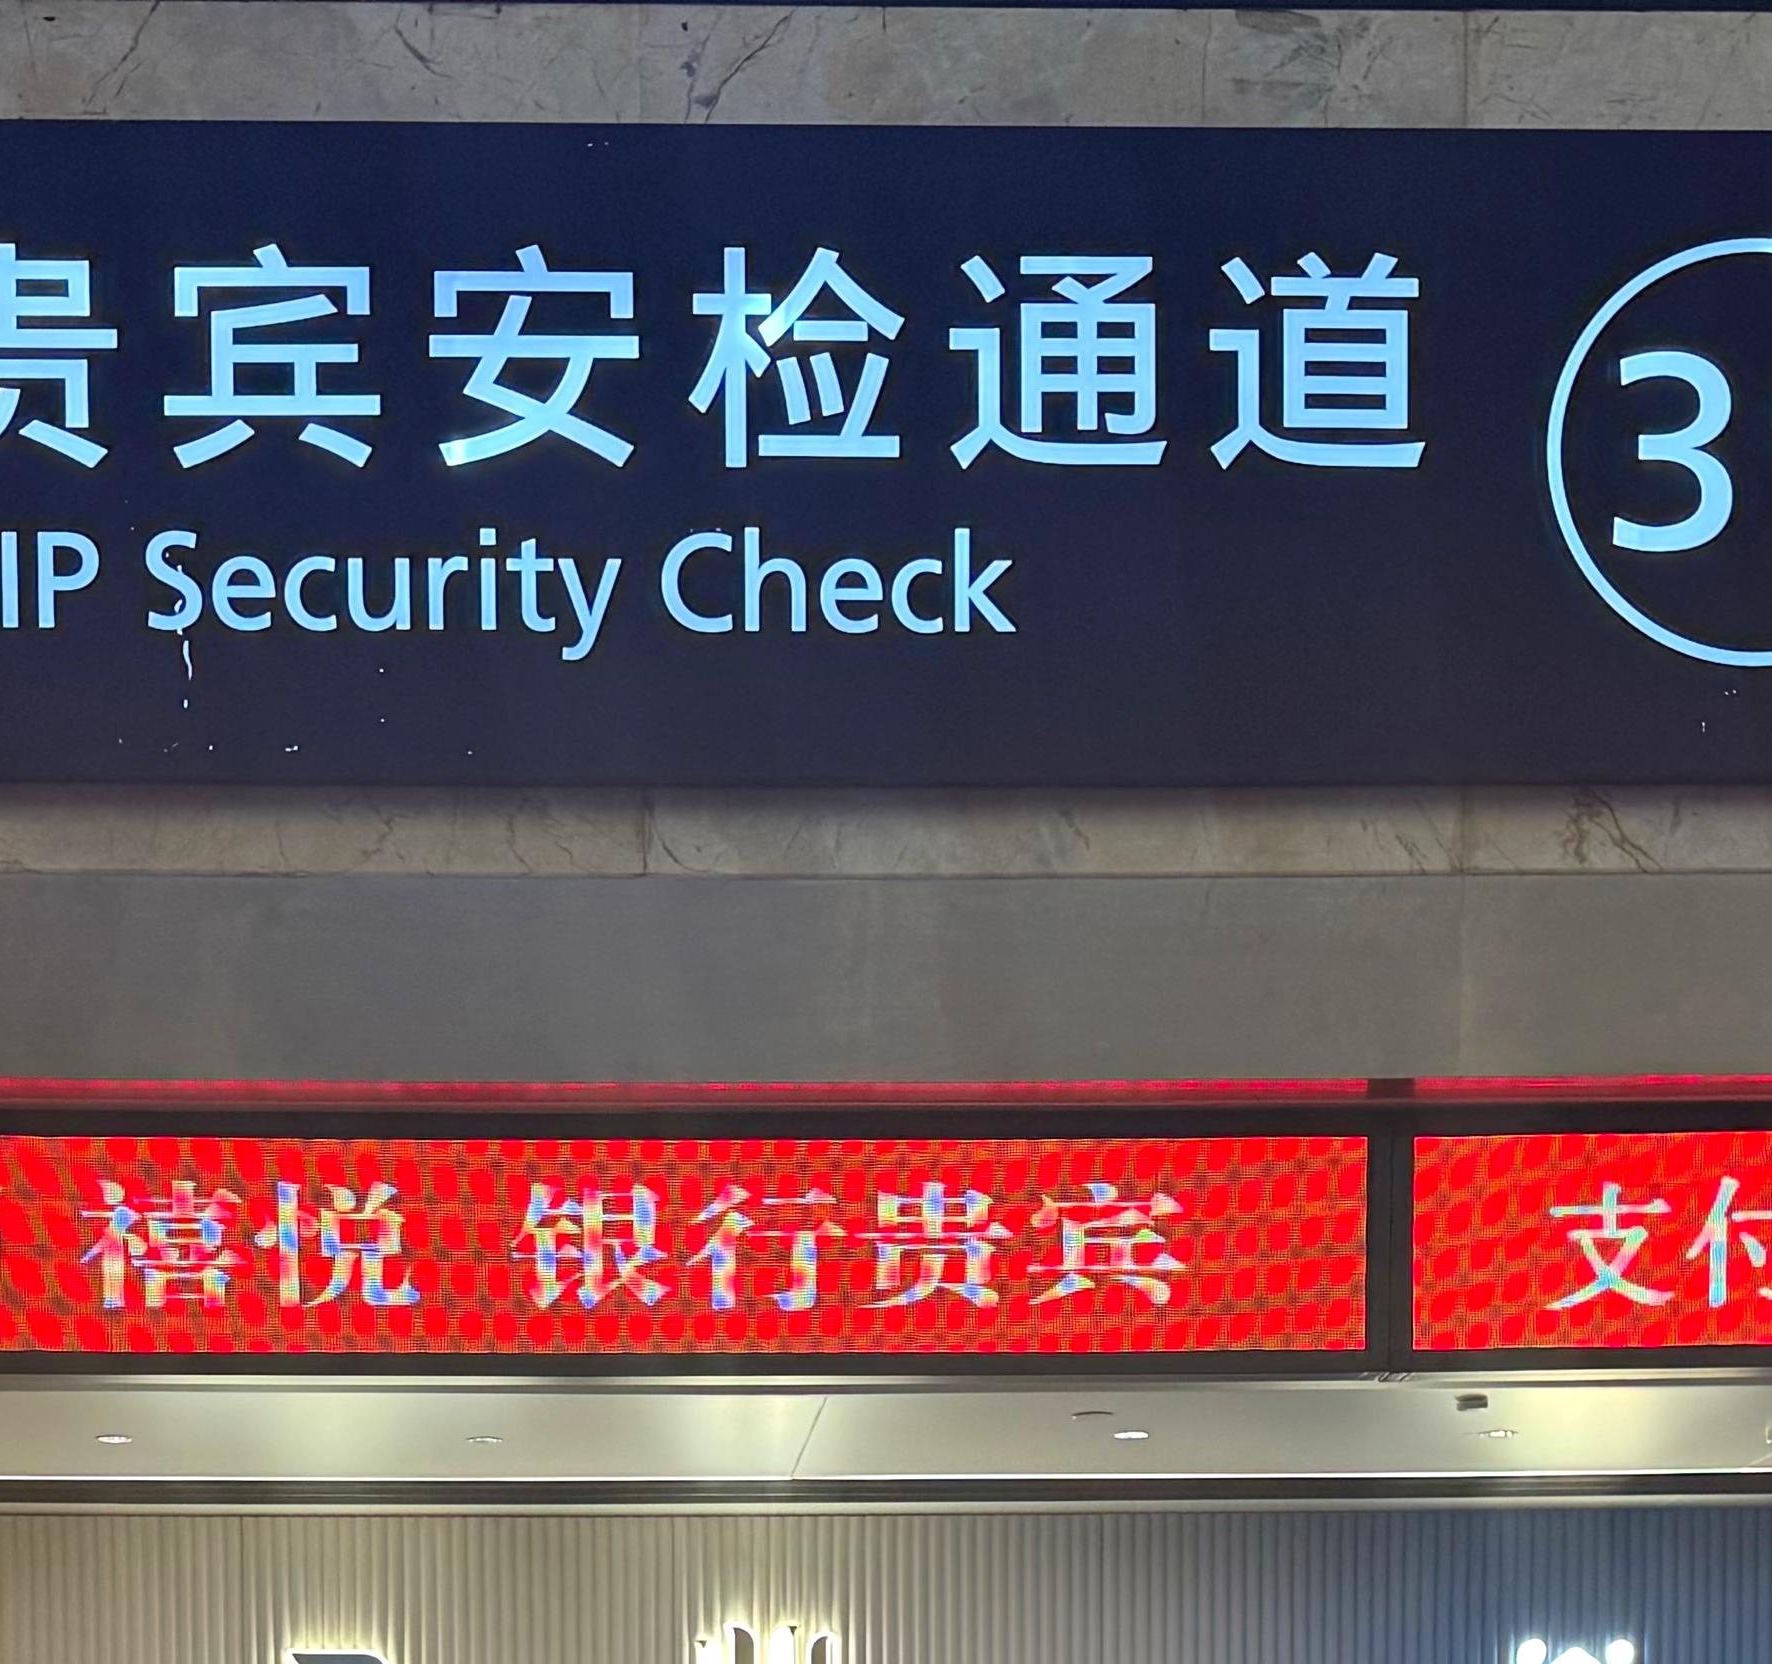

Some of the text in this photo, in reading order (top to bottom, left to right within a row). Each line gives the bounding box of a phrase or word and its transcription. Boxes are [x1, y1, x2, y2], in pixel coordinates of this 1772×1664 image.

[145, 530, 622, 660] Security
[661, 526, 1017, 633] Check
[80, 1179, 1189, 1312] 禧悦 银行贵宾
